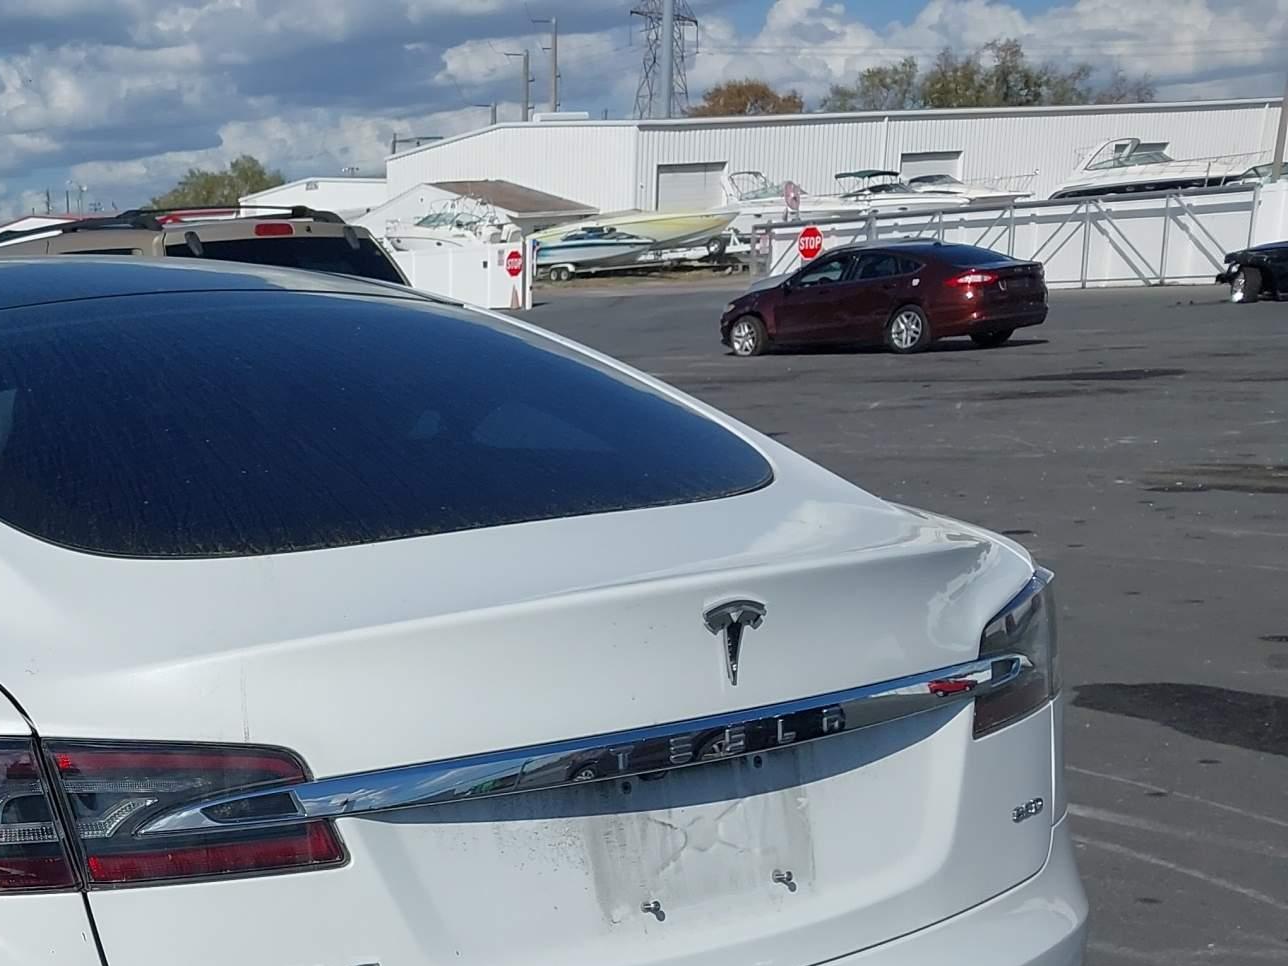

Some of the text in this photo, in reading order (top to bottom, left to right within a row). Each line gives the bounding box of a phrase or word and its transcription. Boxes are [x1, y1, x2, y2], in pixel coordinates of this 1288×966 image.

[799, 236, 822, 251] STOP
[507, 258, 522, 270] STOP
[609, 703, 847, 770] TESLA
